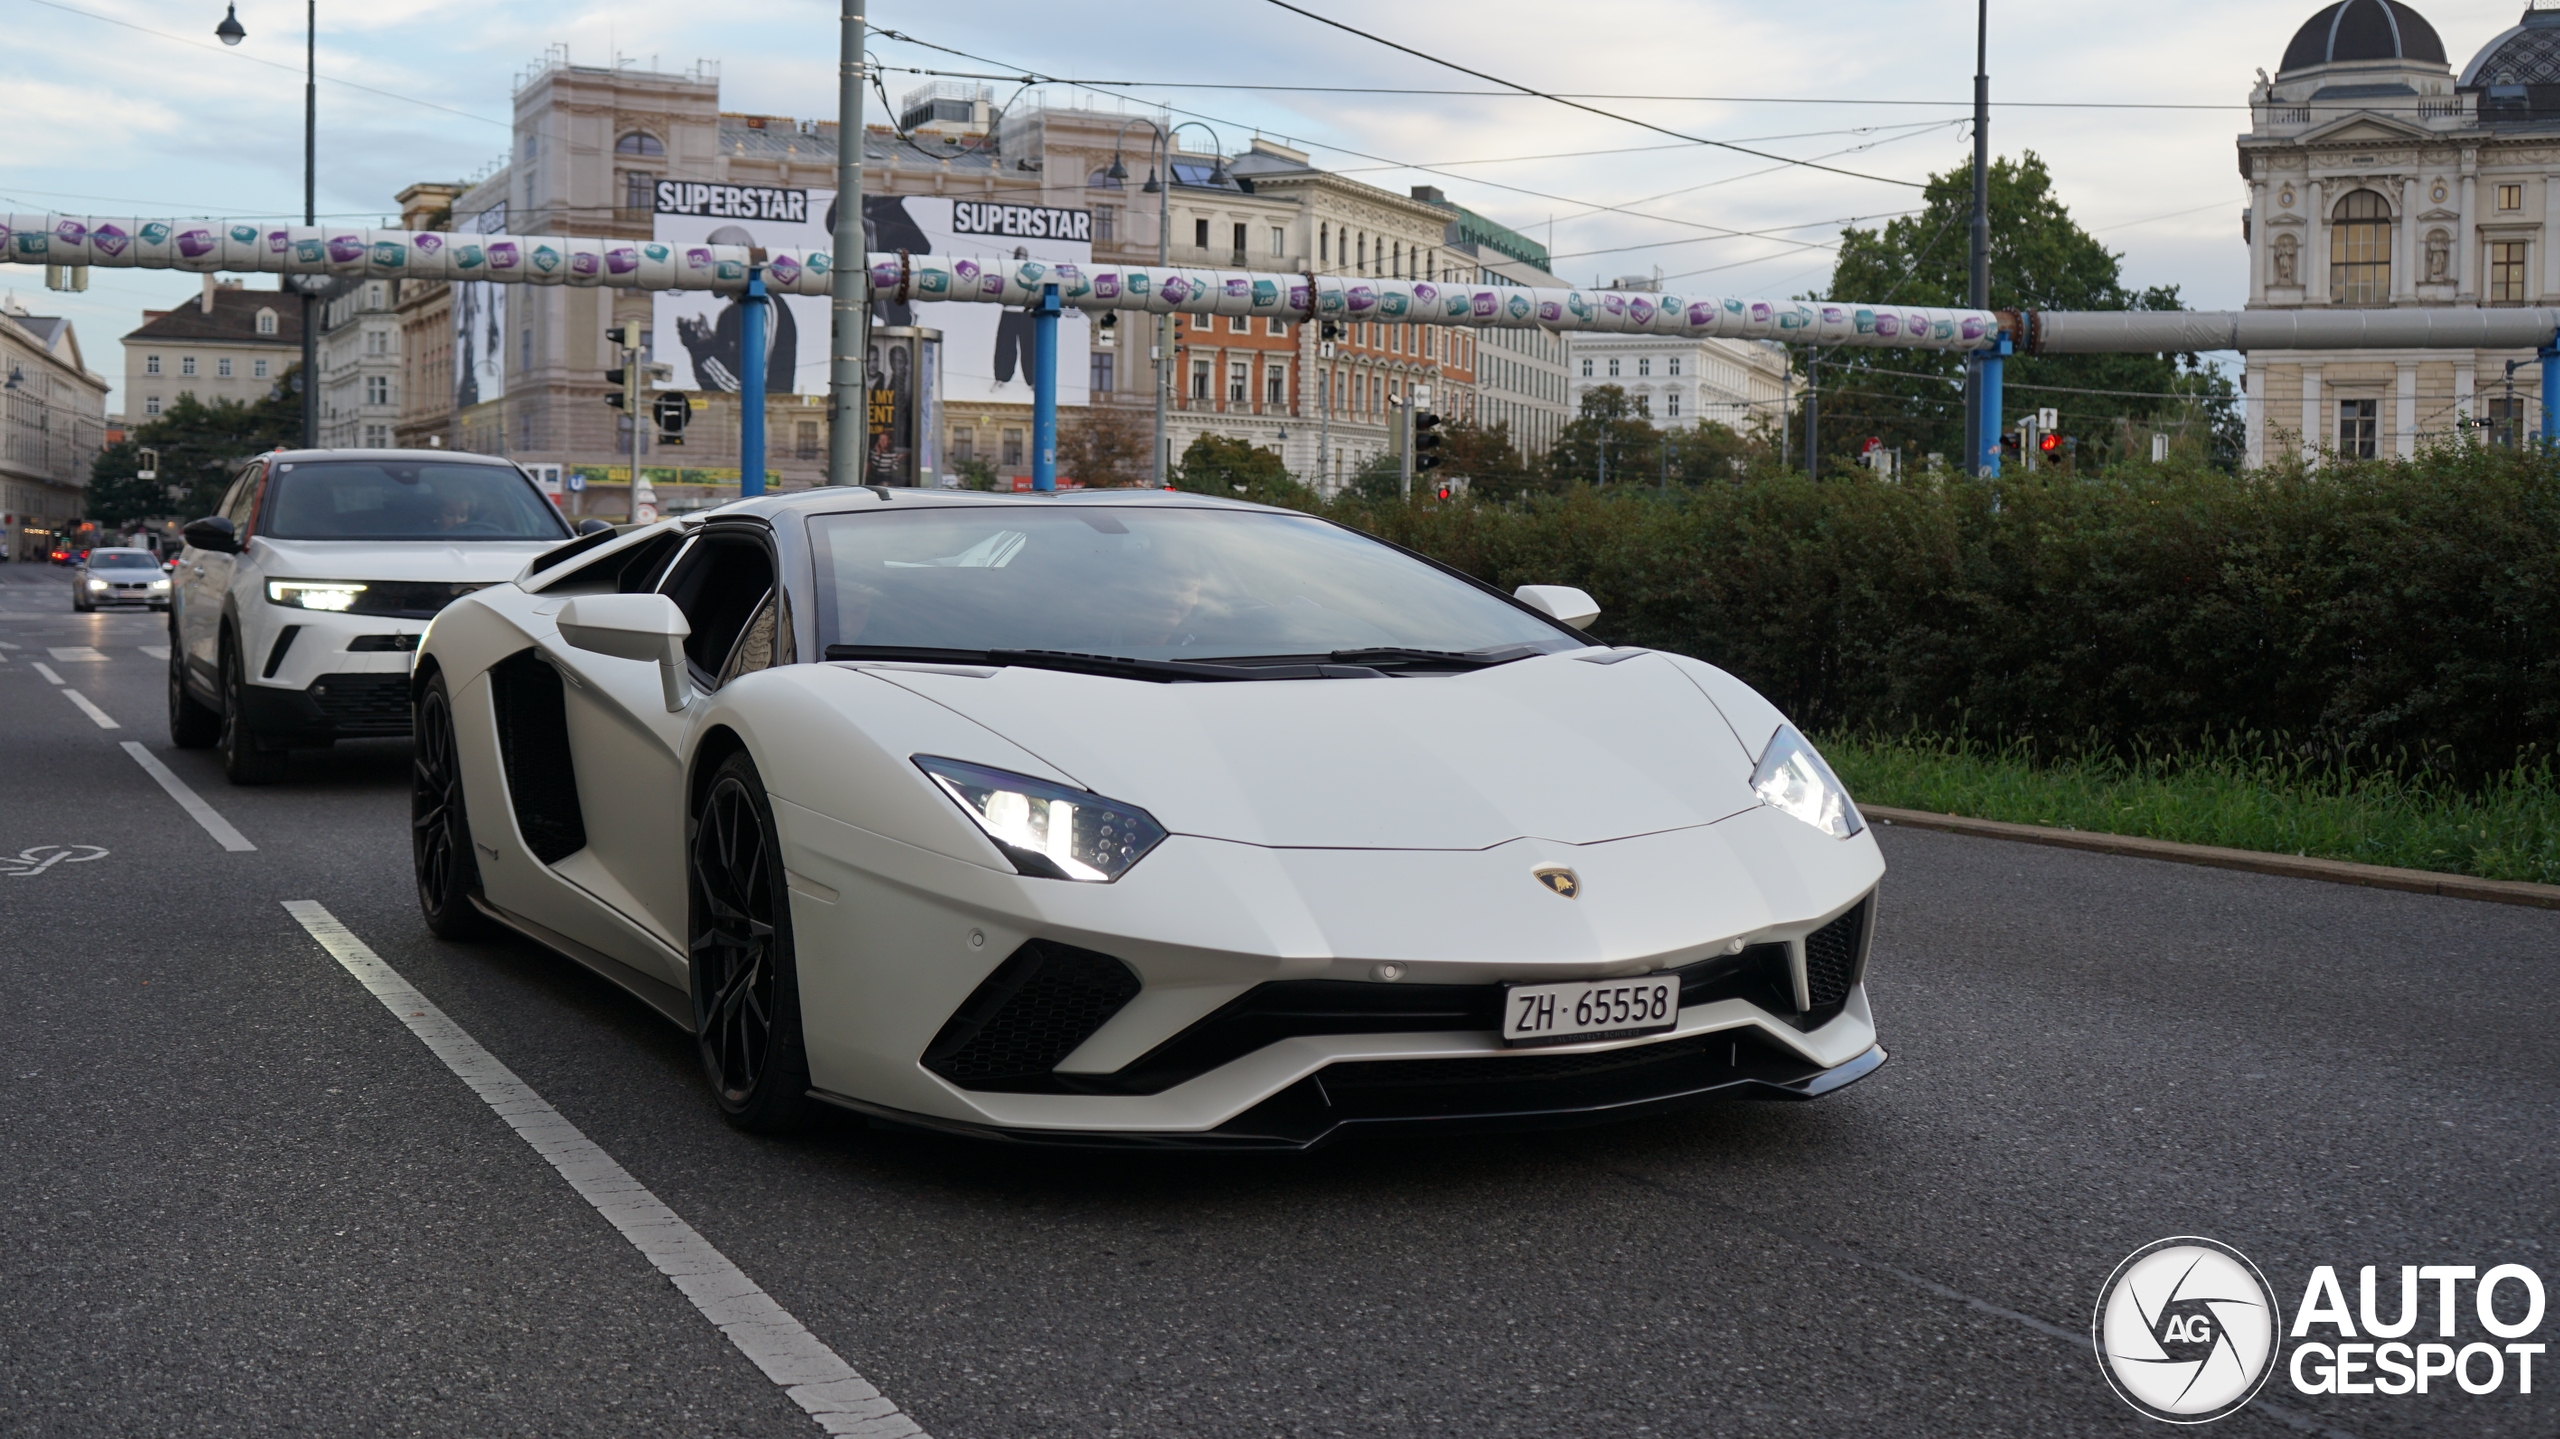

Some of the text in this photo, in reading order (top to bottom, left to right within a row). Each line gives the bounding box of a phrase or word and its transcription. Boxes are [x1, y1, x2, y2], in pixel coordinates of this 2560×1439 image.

[657, 181, 805, 220] SUPERSTAR
[955, 202, 1090, 240] SUPERSTAR
[60, 222, 74, 233] U2
[270, 238, 286, 249] U2
[421, 239, 437, 251] U2
[300, 248, 315, 261] U5
[375, 250, 393, 262] U5
[490, 252, 509, 265] U2
[574, 258, 588, 269] U2
[962, 268, 977, 280] U2
[921, 275, 937, 288] U5
[1096, 283, 1113, 295] U2
[1259, 296, 1275, 305] U5
[1421, 290, 1433, 301] U2
[1323, 298, 1336, 308] U5
[1383, 298, 1397, 311] U5
[1475, 301, 1489, 313] U2
[1542, 306, 1553, 317] U2
[1884, 322, 1897, 332] U2
[1936, 327, 1947, 337] U5
[875, 389, 895, 404] MY
[868, 406, 895, 423] ENT
[571, 477, 582, 491] U
[1557, 1029, 1641, 1043] AUTOWELT SCHWEIZ
